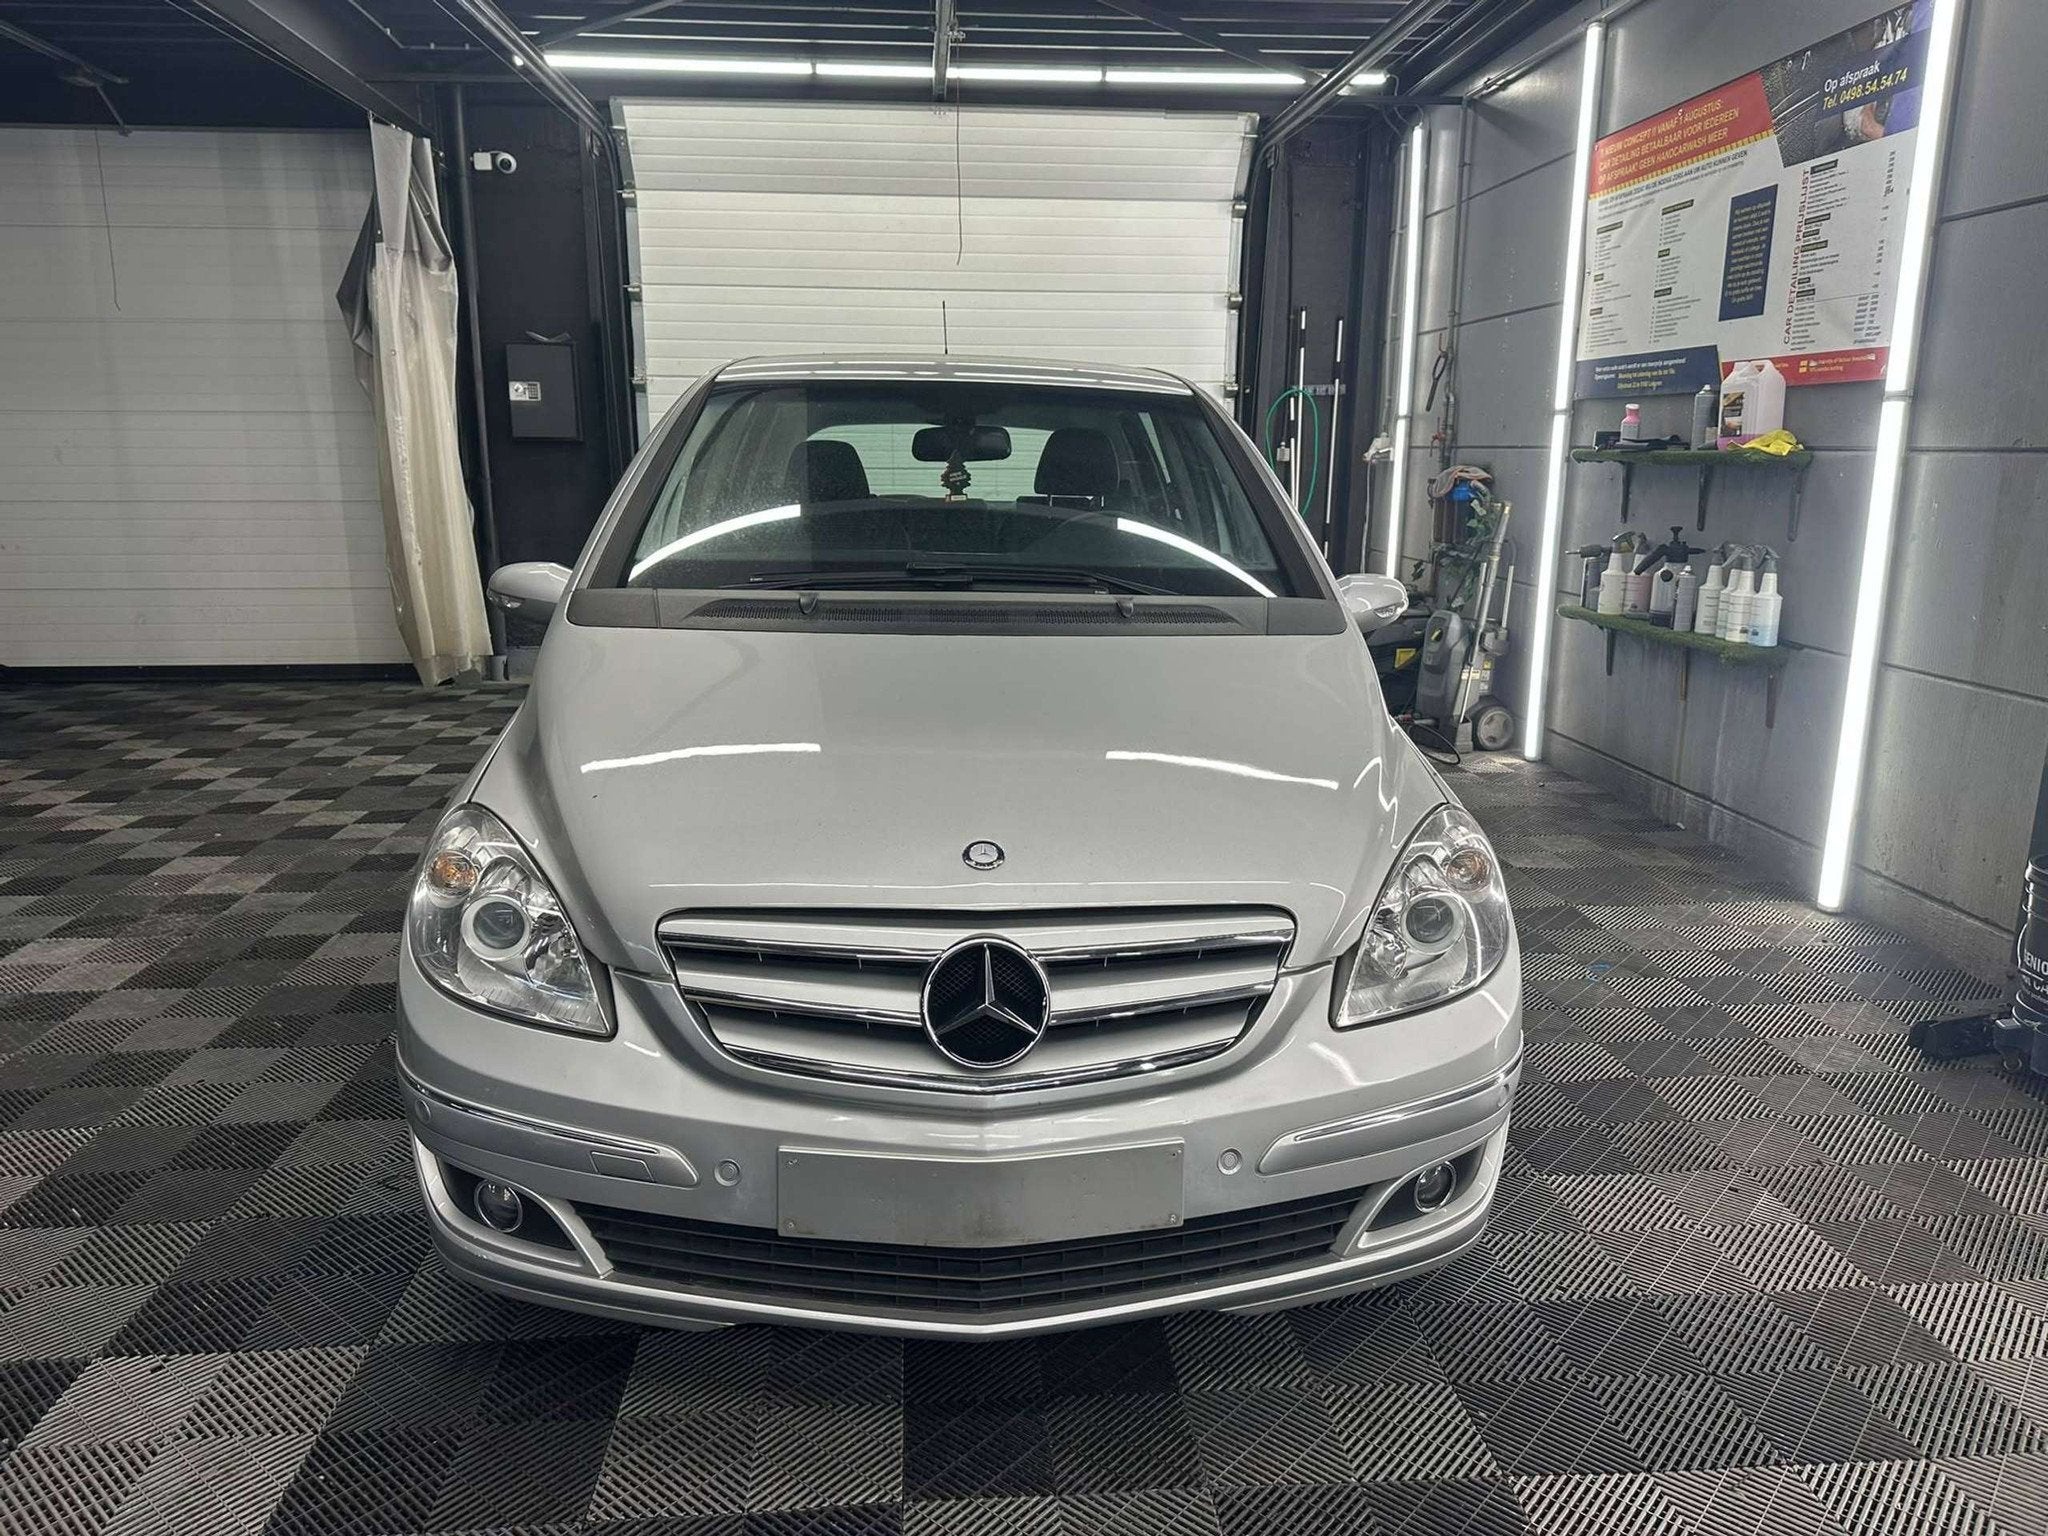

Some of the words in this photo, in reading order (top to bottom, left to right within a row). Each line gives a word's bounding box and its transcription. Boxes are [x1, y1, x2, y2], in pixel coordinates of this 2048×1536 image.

[1823, 95, 1837, 110] Tel.
[1840, 67, 1908, 103] 0498.54.54.74
[1824, 79, 1838, 93] Op
[1840, 60, 1880, 87] afspraak
[1683, 122, 1702, 138] VOOR
[1703, 108, 1739, 130] IEDEREEN
[1795, 170, 1809, 241] PRIJSLIJST
[1787, 246, 1800, 314] DETAILING
[1784, 317, 1792, 344] CAR
